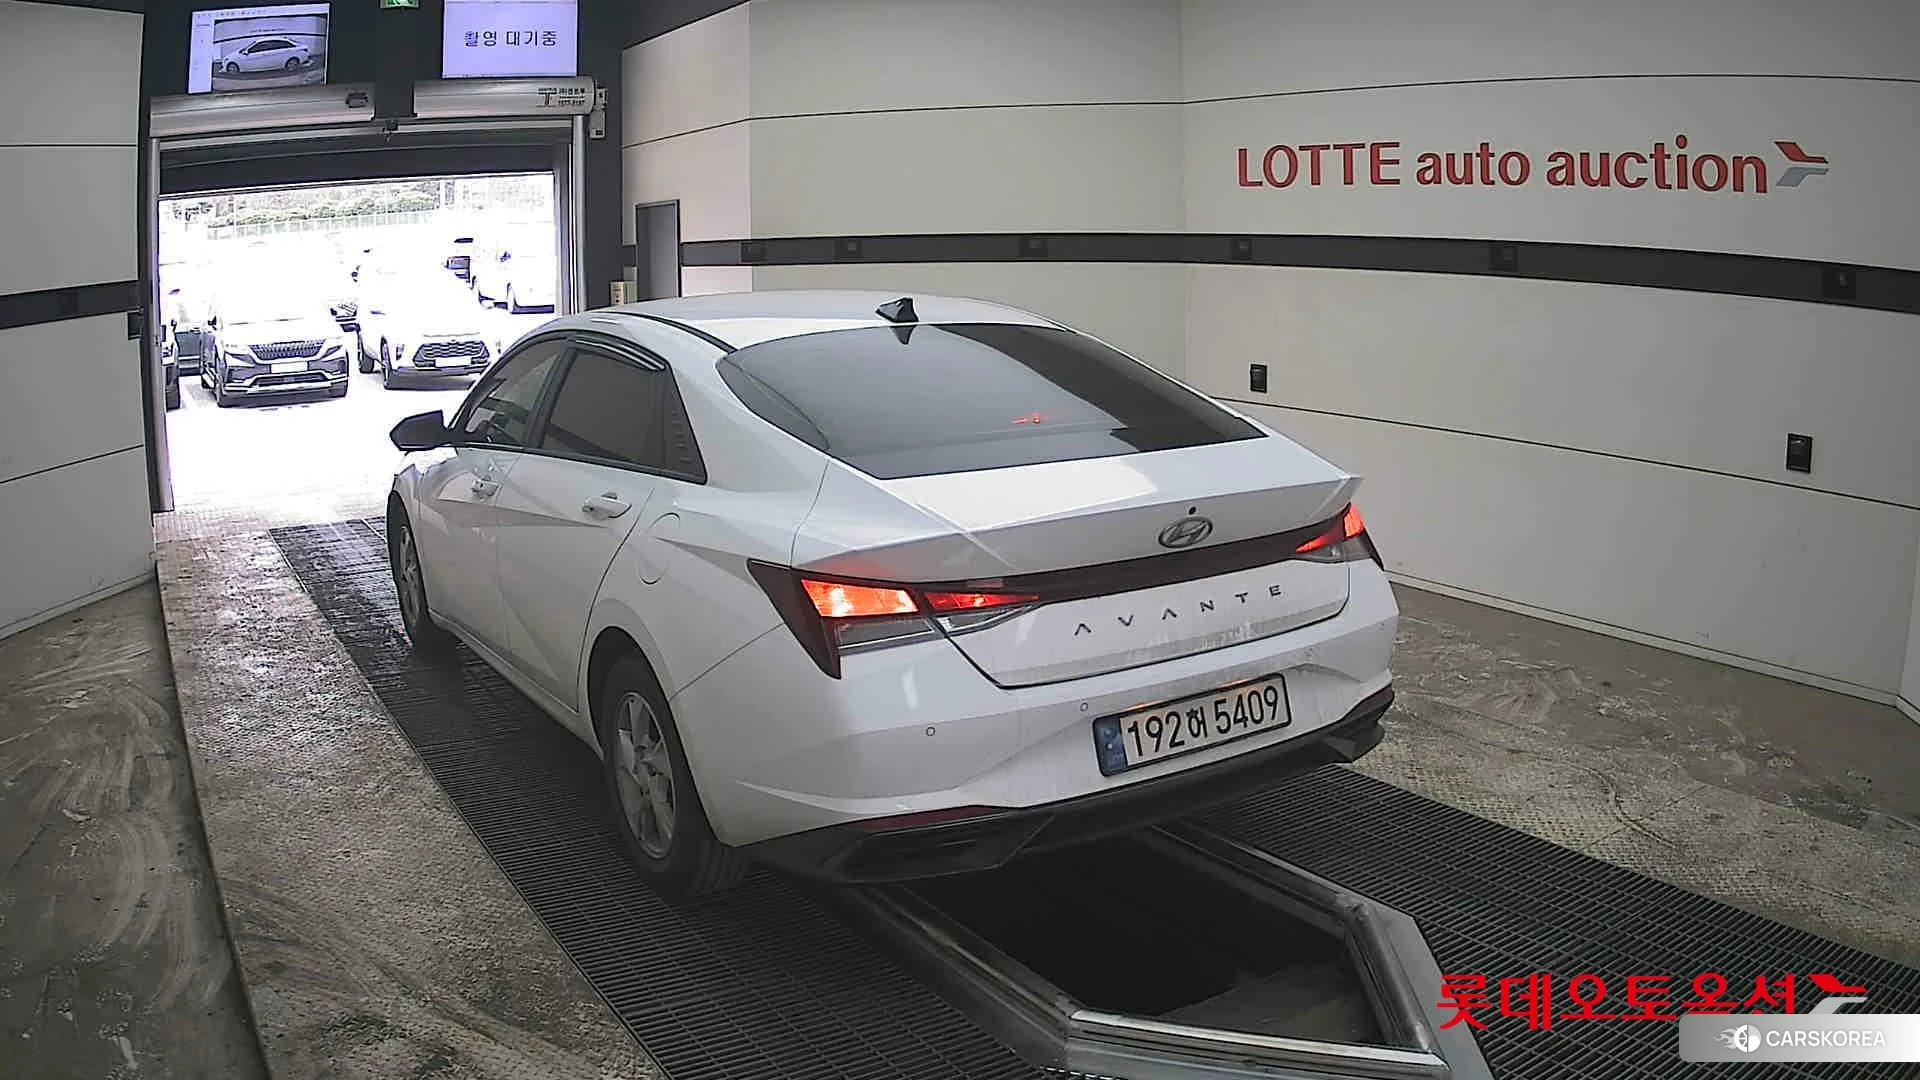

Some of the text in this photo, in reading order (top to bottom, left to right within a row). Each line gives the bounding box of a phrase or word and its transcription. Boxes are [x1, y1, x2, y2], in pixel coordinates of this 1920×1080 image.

[506, 31, 557, 47] 대기중
[1237, 134, 1768, 194] LOTTE auto auction
[1074, 585, 1282, 636] AVANTE
[1127, 685, 1279, 757] 192허 5409
